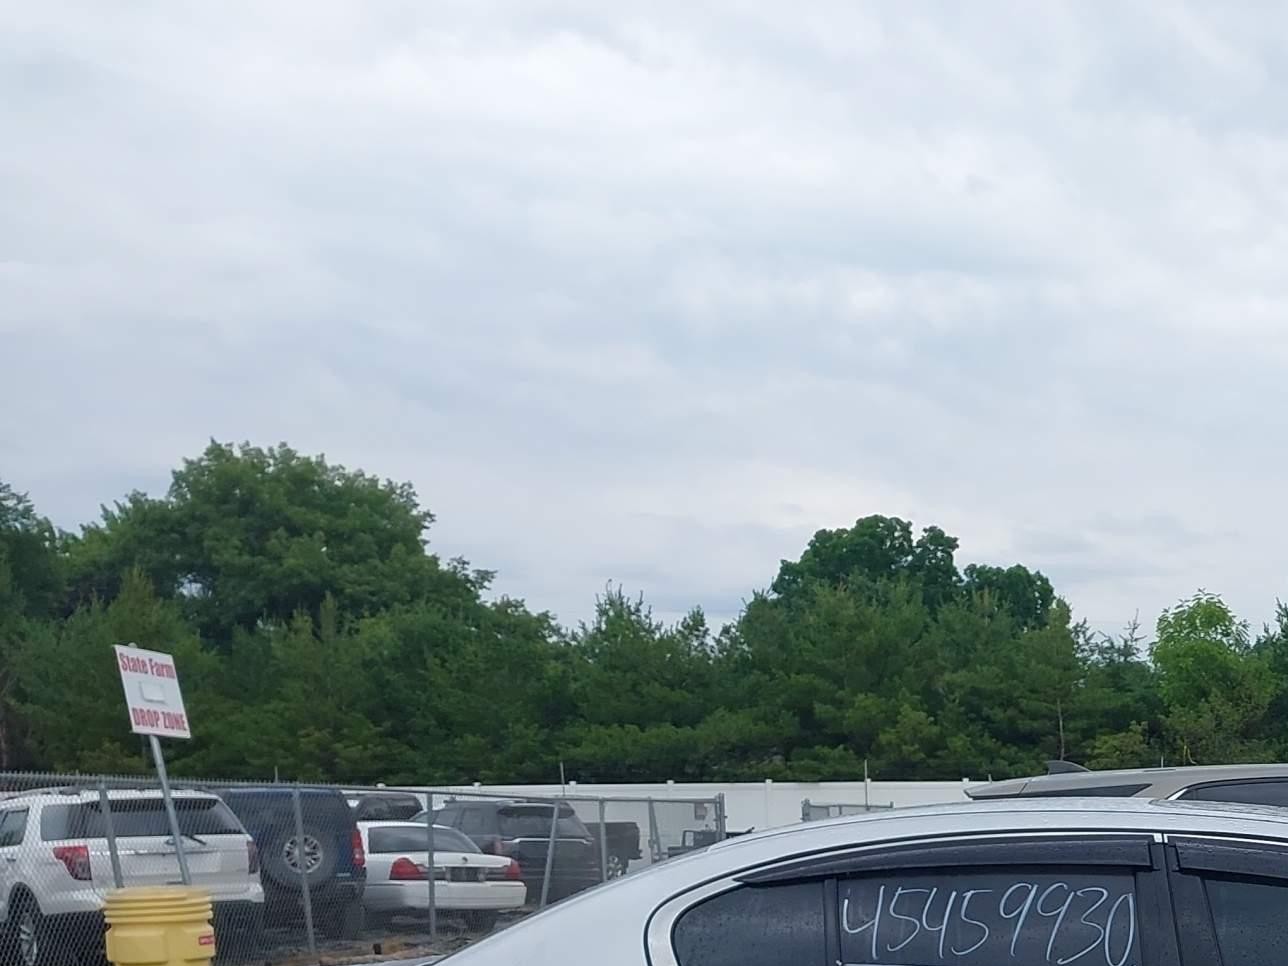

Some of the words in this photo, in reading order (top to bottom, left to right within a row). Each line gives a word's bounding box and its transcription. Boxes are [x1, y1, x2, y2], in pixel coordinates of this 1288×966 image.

[119, 653, 148, 674] State
[148, 658, 176, 679] Farm
[132, 707, 160, 728] DROP
[160, 711, 187, 731] ZONE
